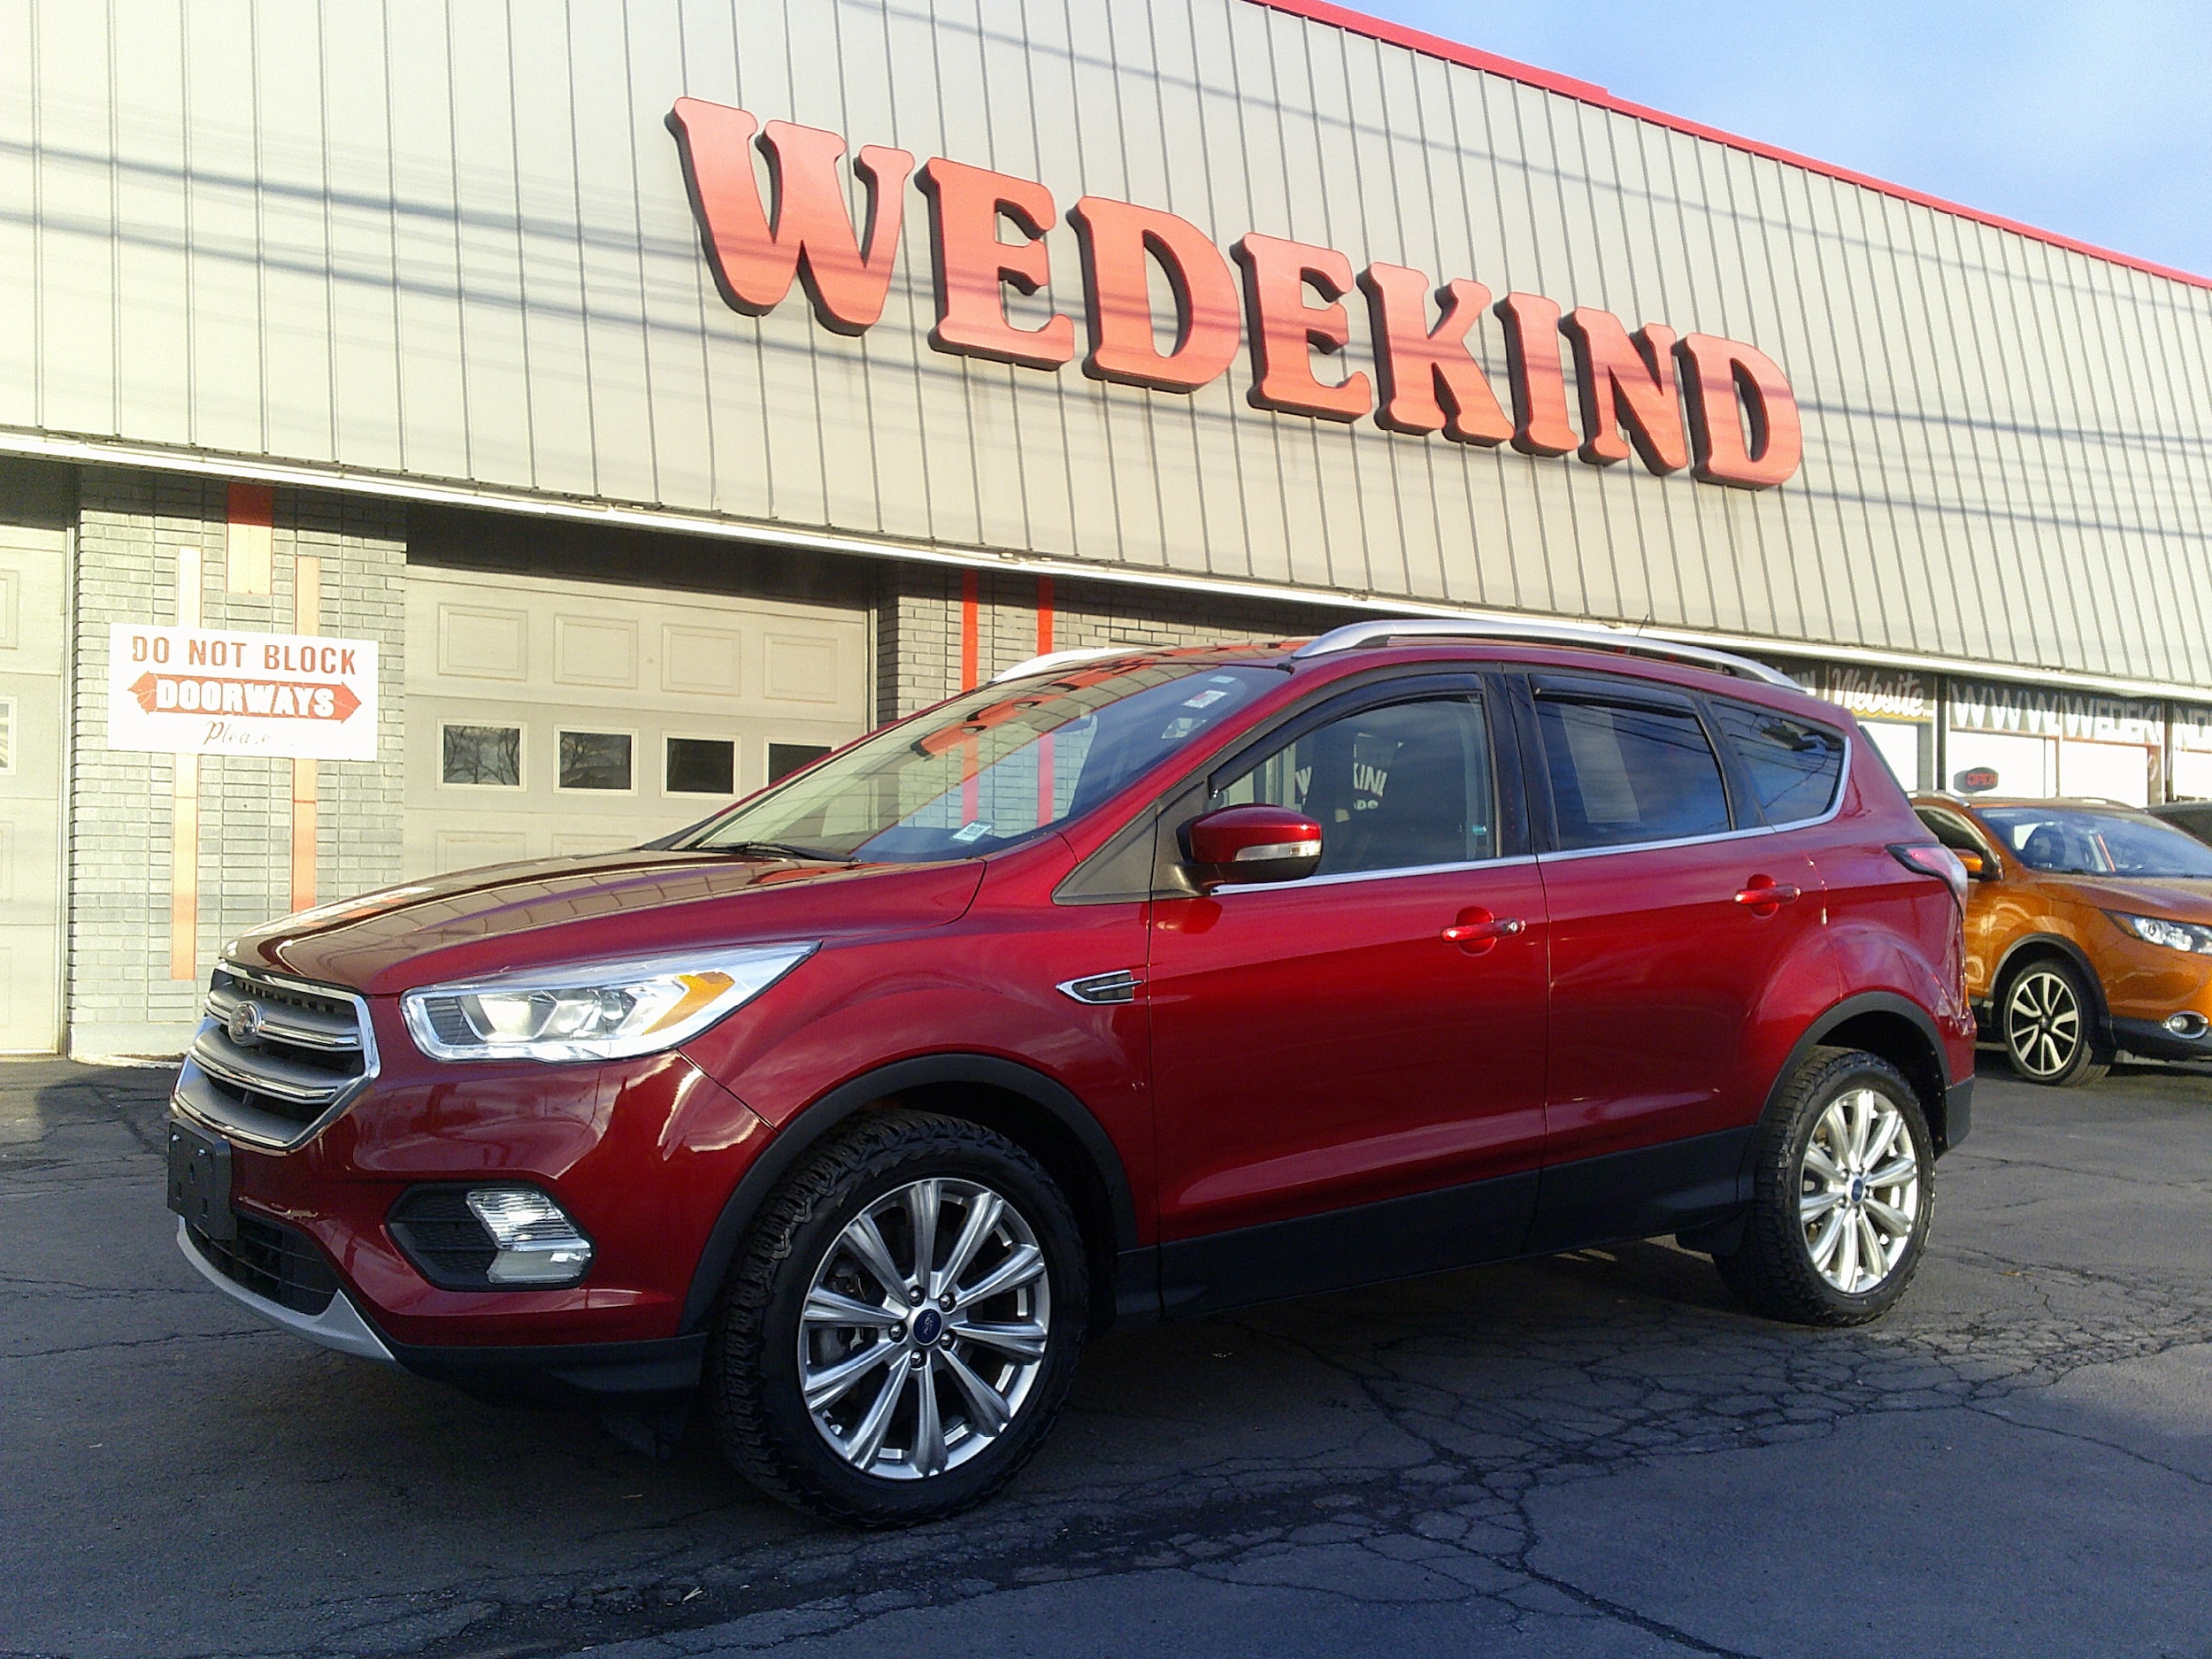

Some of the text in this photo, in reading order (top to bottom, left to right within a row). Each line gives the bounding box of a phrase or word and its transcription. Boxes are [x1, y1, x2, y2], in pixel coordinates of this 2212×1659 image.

[666, 96, 1801, 489] WEDEKIND
[132, 635, 356, 675] DO NOT BLOCK
[156, 678, 335, 718] DOORWAYS
[204, 720, 270, 745] Pleae
[1967, 772, 1997, 787] OPEN
